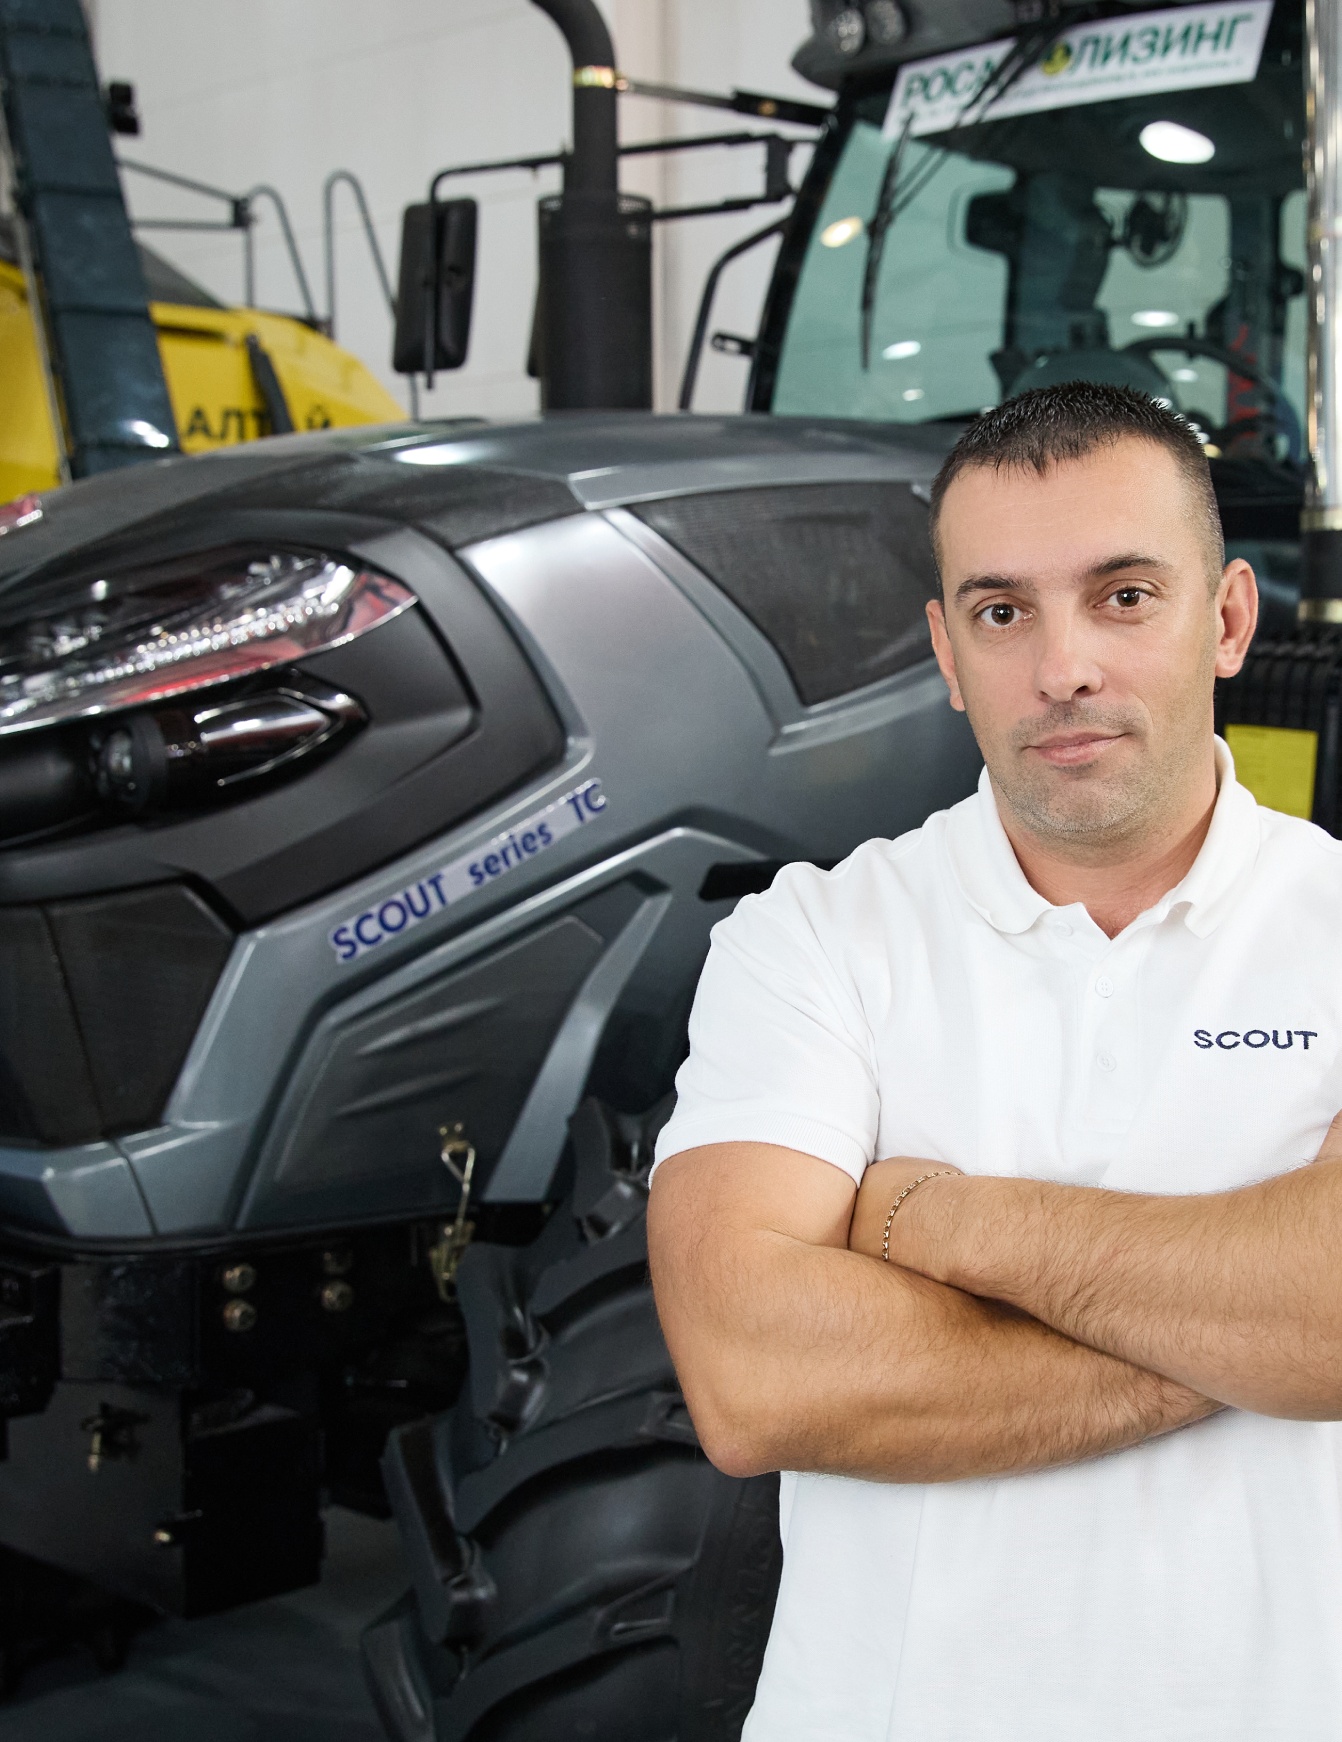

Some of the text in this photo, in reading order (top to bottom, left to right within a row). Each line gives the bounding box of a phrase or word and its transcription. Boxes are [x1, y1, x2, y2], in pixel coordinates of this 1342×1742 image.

[186, 405, 331, 441] АЛТЙ
[332, 782, 607, 960] SCOUT series TC
[1194, 1029, 1318, 1050] SCOUT
